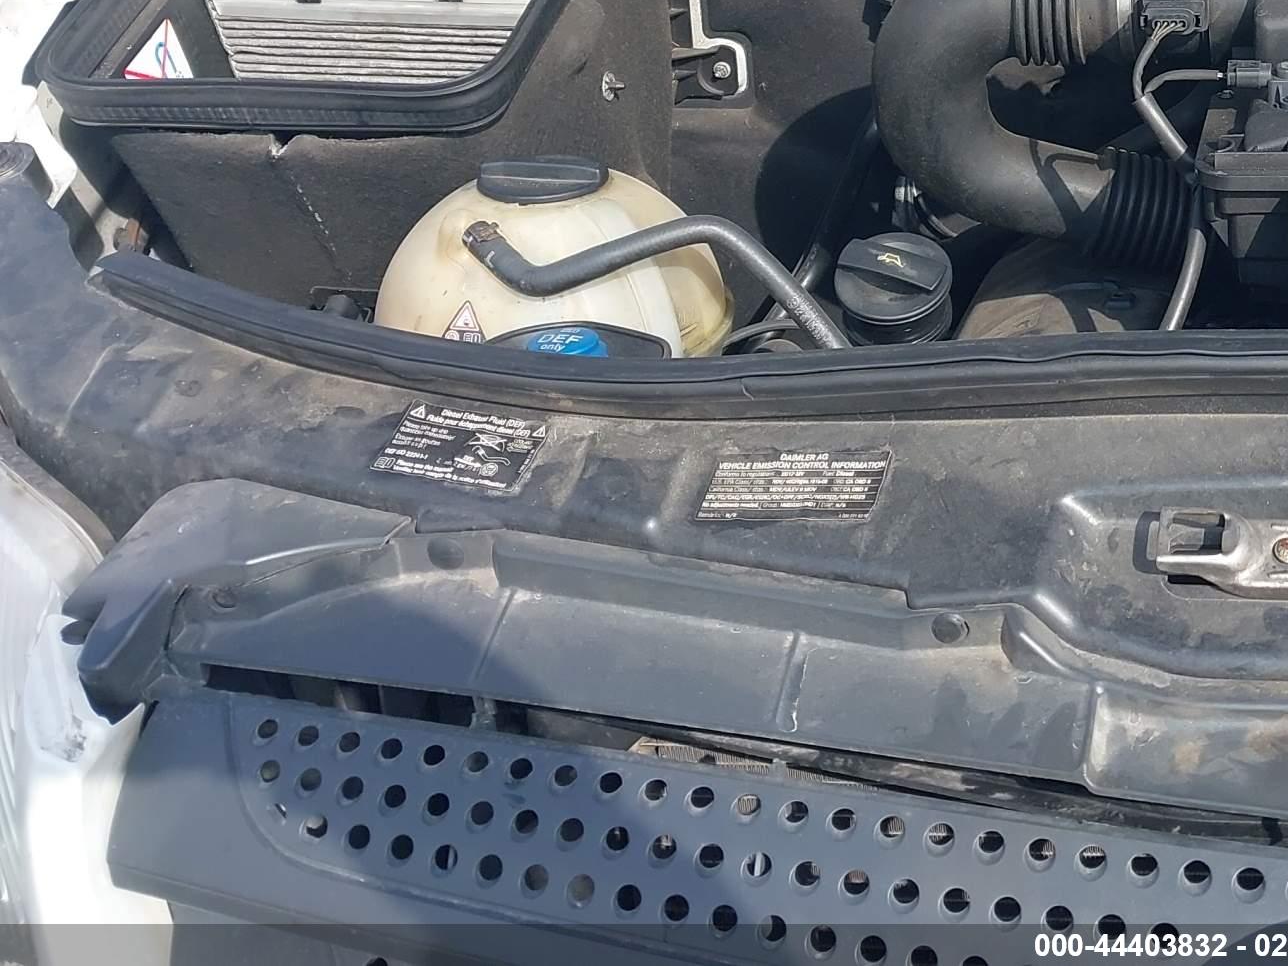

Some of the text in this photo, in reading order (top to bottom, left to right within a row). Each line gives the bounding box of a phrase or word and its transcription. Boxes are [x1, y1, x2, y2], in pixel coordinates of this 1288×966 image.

[538, 333, 583, 344] DEF
[540, 343, 565, 352] only
[489, 415, 507, 426] Fluid
[780, 453, 829, 461] DAIMLER AG
[718, 460, 886, 470] VEHICLE EMISSION CONTROL INFORMATION
